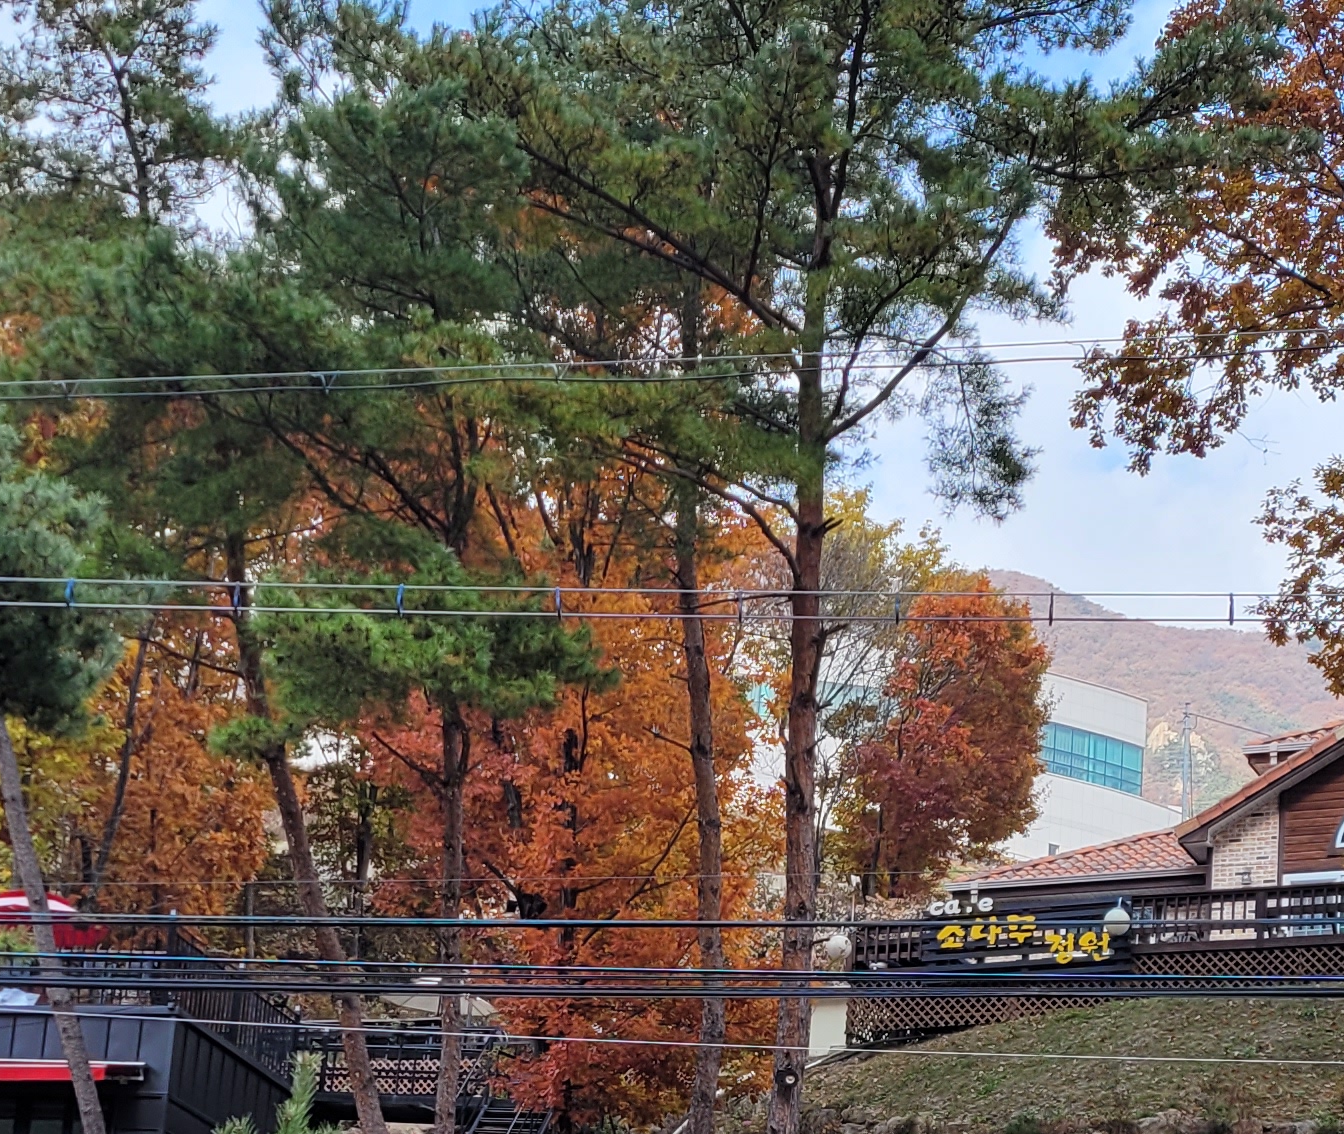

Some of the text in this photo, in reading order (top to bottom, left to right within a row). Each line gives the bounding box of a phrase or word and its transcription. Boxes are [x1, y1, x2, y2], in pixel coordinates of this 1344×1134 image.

[929, 897, 994, 916] cae
[937, 914, 1112, 964] 소나무 정원
